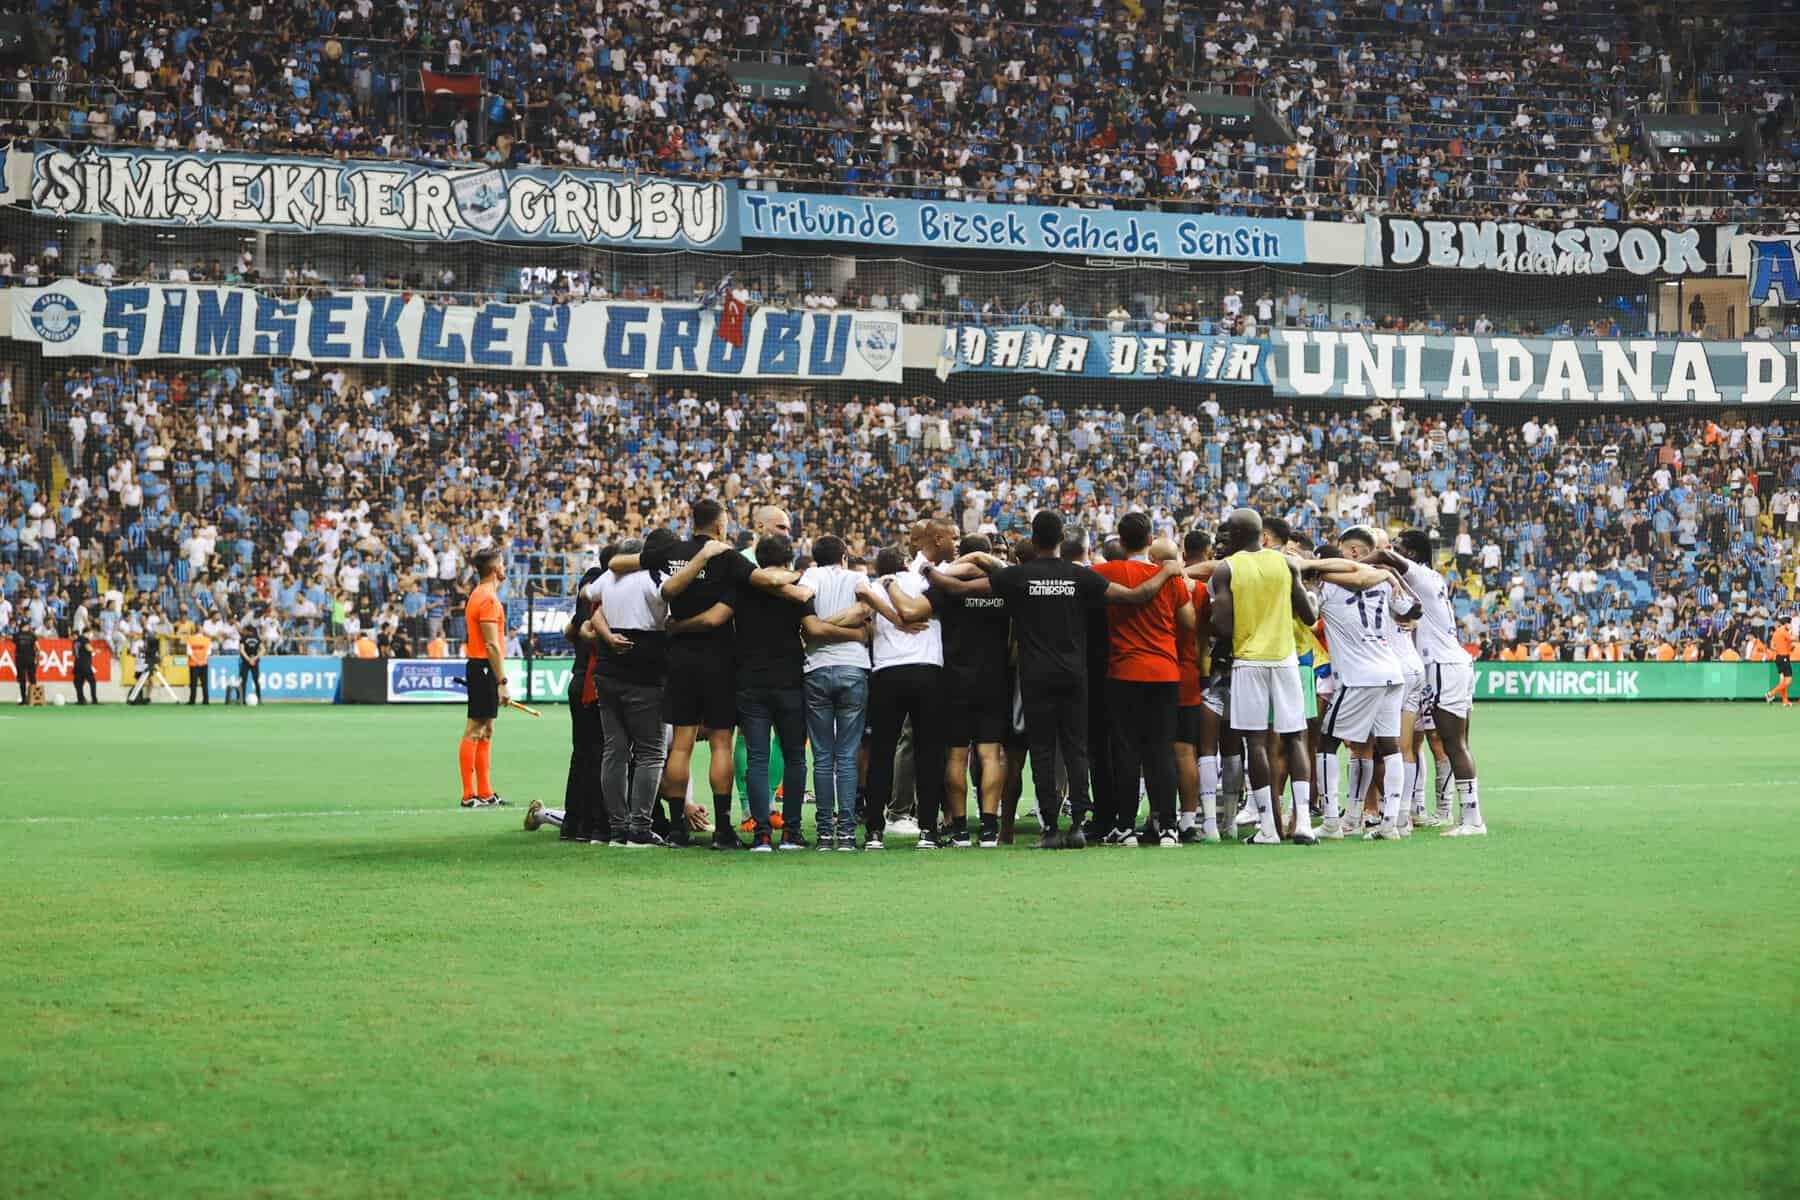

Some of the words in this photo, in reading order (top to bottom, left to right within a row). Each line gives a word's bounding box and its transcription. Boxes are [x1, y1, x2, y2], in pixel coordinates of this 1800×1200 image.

[507, 174, 725, 242] GRUBU
[746, 195, 897, 237] Tribünde
[919, 204, 1027, 245] Bizsek
[1039, 212, 1160, 253] Sahada
[1177, 220, 1280, 257] Sensin
[603, 304, 851, 376] GRUBU
[1282, 330, 1425, 399] UNI
[1443, 335, 1722, 402] ADANA
[1345, 590, 1385, 630] 17
